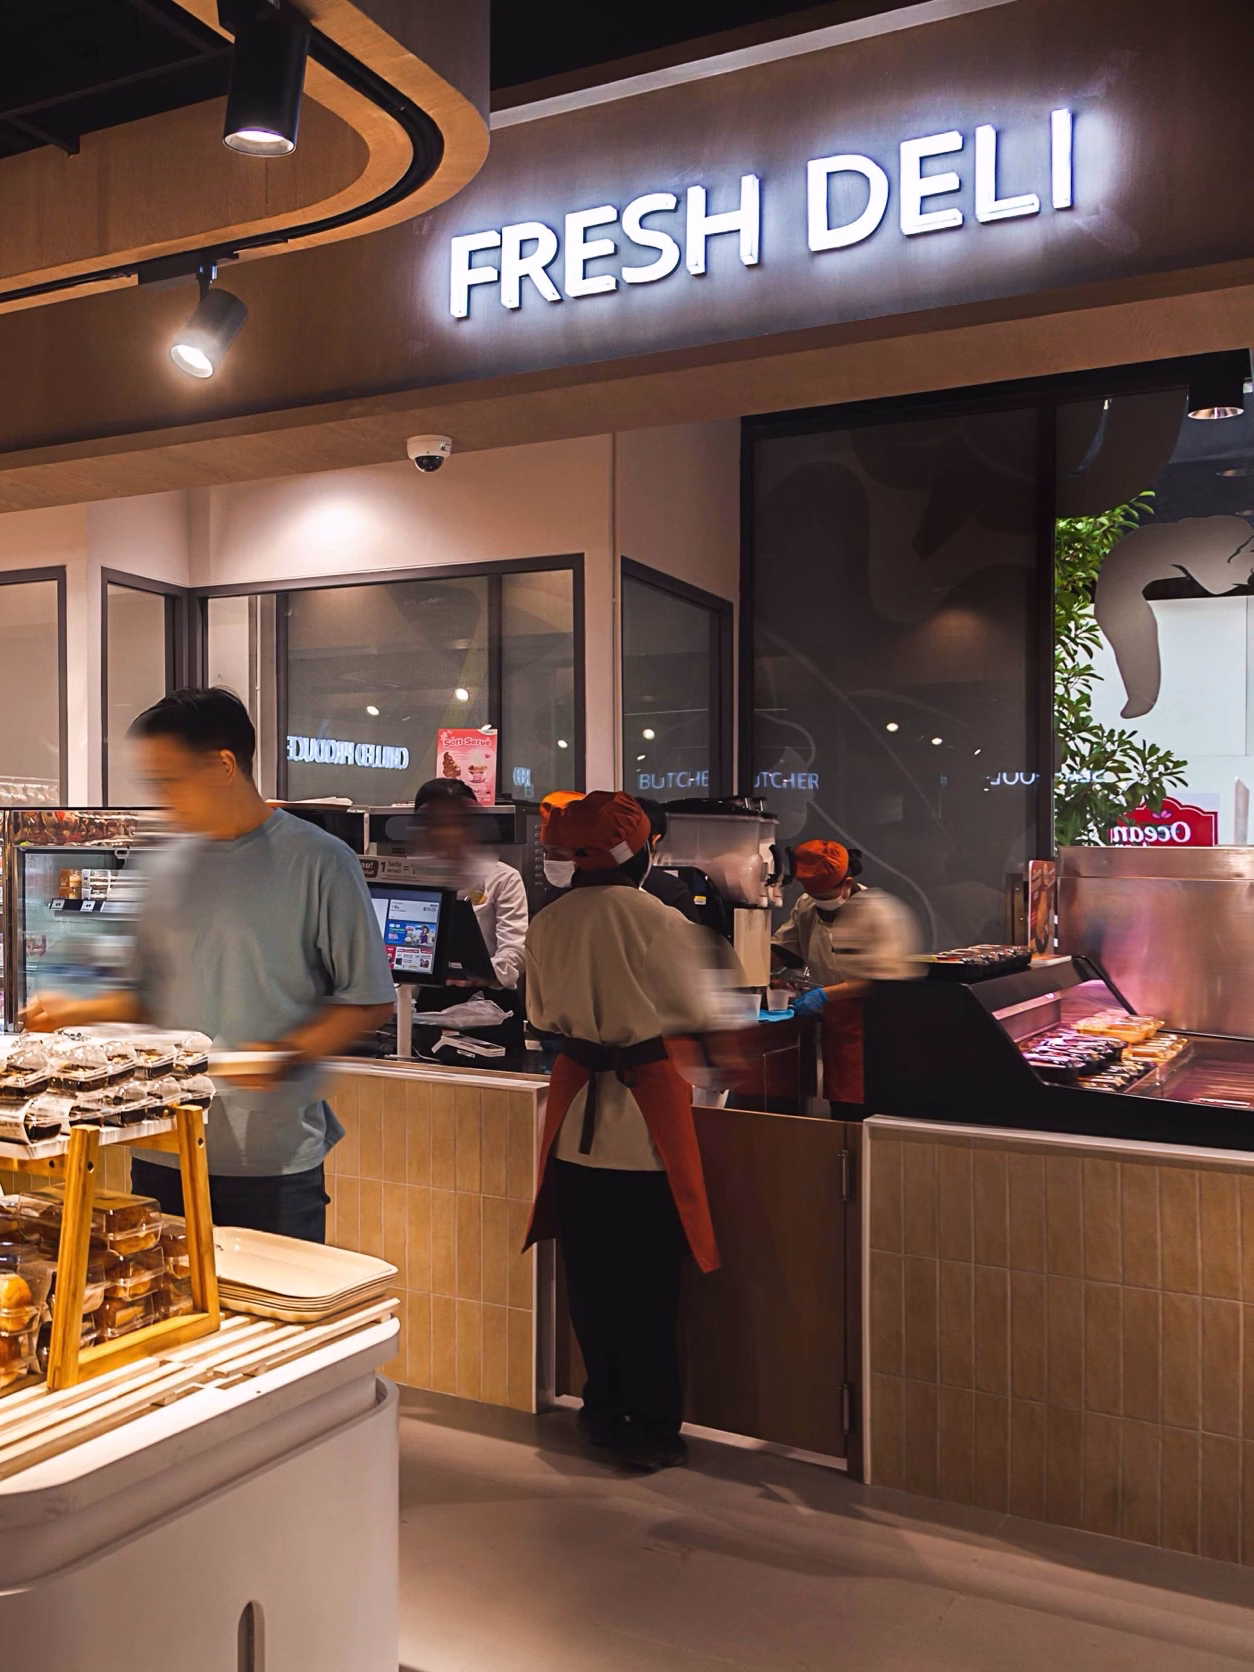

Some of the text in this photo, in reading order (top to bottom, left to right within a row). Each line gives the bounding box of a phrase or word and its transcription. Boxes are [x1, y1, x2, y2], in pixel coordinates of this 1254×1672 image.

[449, 107, 1074, 319] FRESH DELI
[443, 738, 491, 748] Soft Serve
[380, 861, 386, 873] 1
